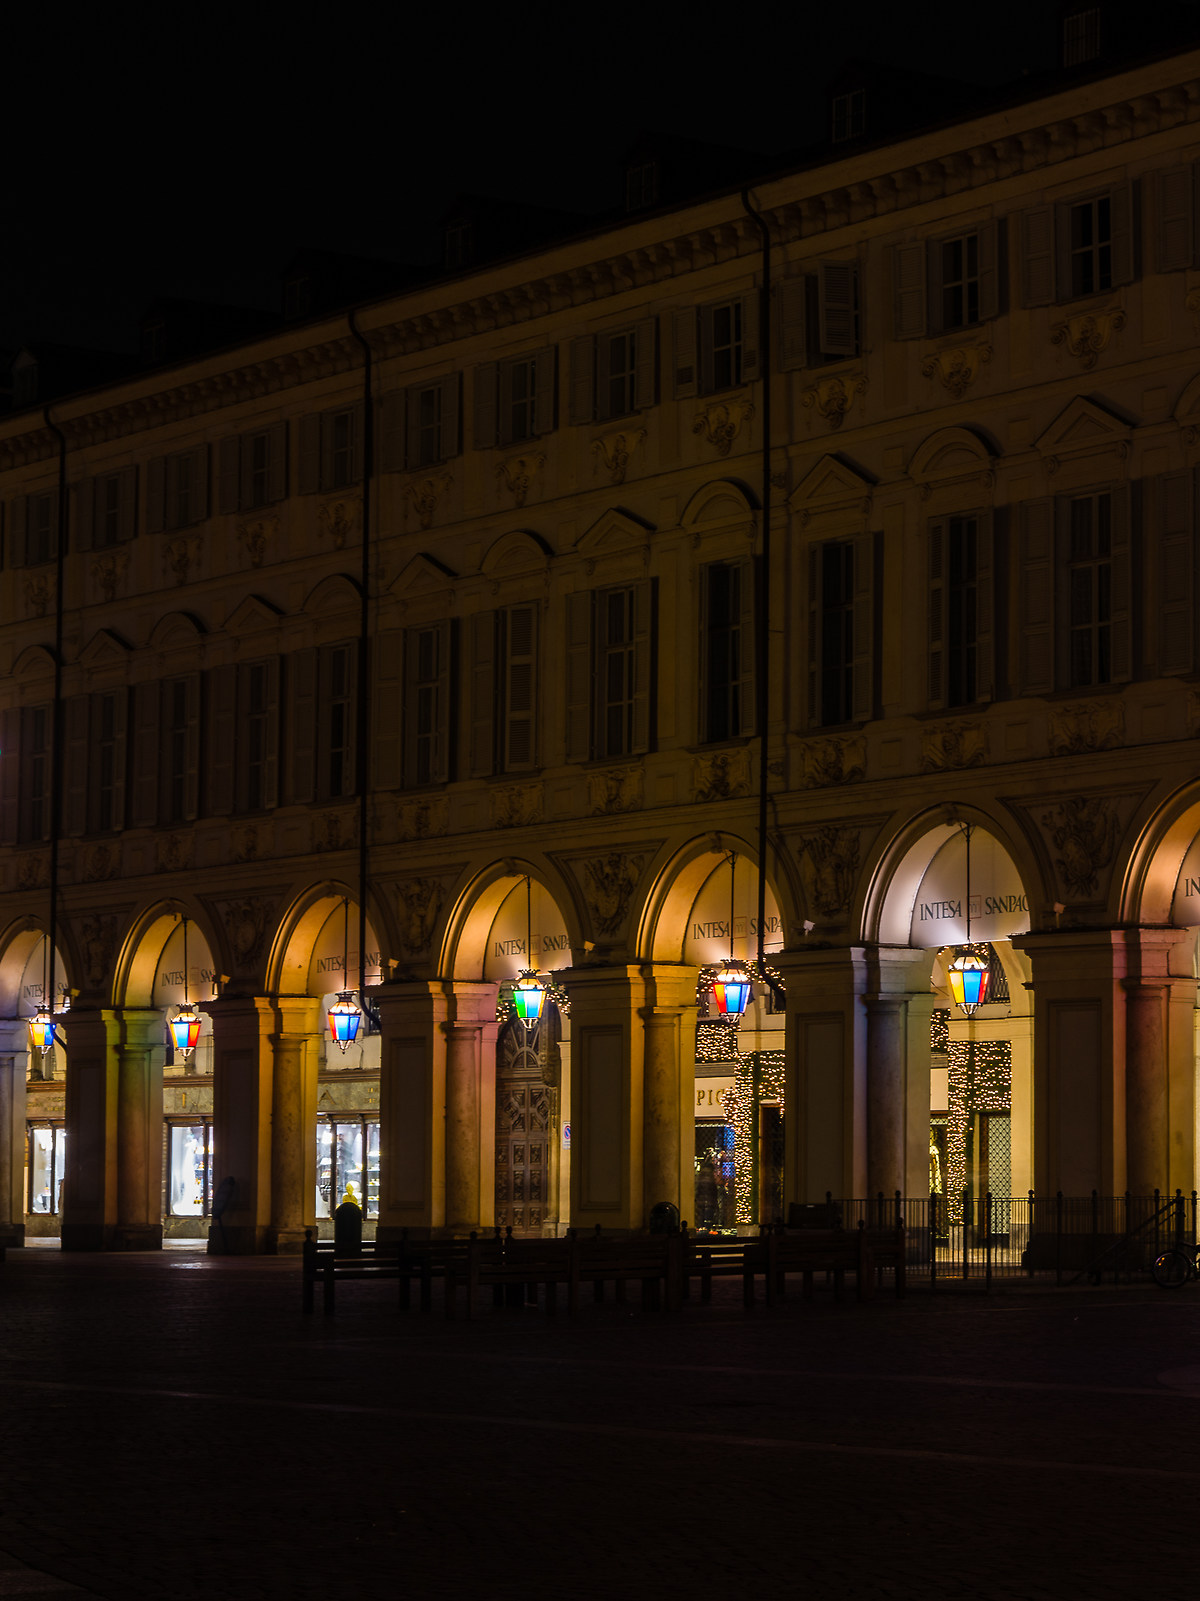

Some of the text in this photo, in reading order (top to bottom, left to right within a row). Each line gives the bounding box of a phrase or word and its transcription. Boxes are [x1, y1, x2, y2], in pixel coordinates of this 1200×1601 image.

[920, 900, 962, 921] INTESA
[693, 921, 730, 940] INTESA
[495, 939, 526, 957] INTESA
